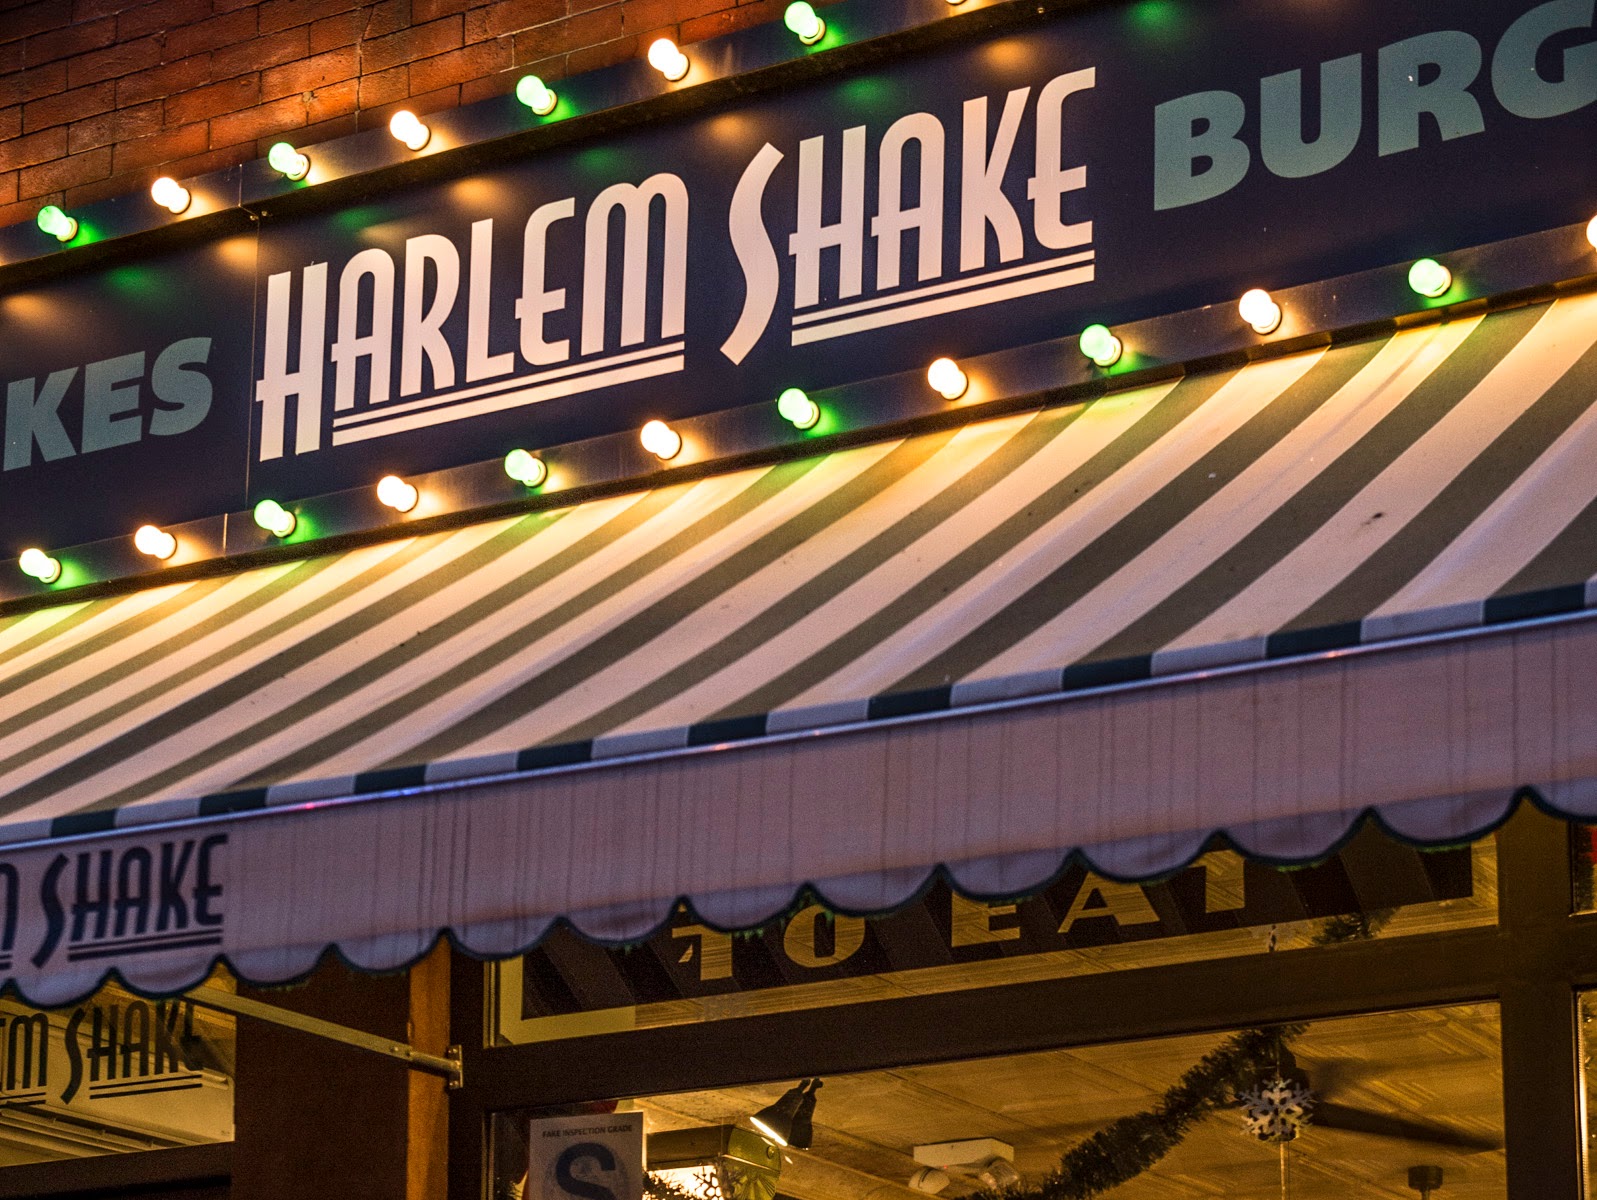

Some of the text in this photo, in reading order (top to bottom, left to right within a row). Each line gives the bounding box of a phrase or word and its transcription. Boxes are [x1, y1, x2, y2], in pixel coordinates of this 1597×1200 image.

[1153, 0, 1597, 211] BURG
[256, 66, 1097, 462] HARLEM SHAKE
[2, 337, 214, 472] KES
[31, 832, 229, 969] SHAKE
[61, 999, 204, 1105] SHAKE
